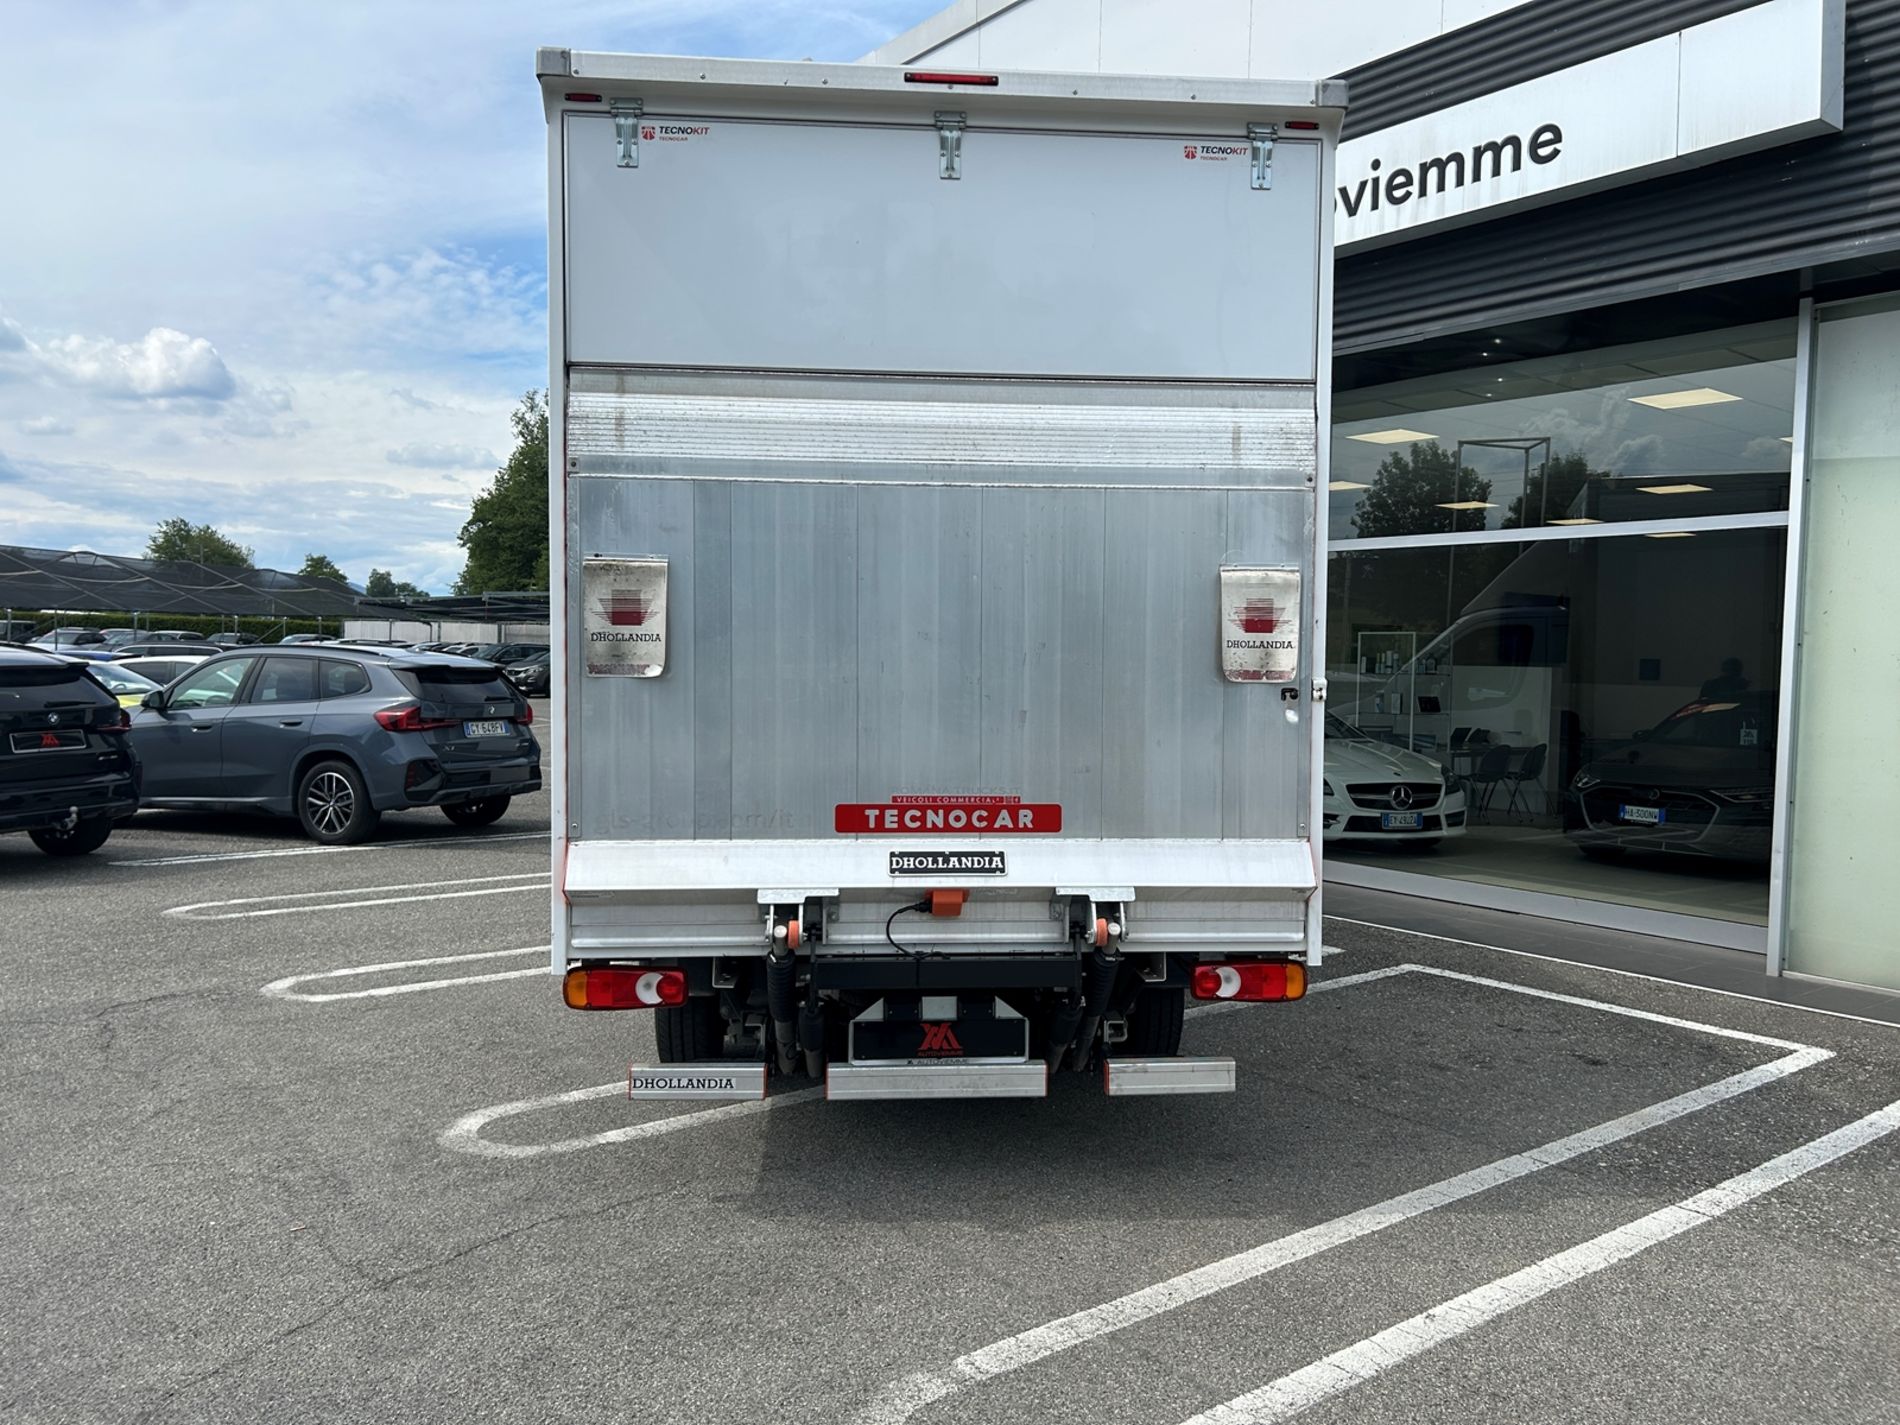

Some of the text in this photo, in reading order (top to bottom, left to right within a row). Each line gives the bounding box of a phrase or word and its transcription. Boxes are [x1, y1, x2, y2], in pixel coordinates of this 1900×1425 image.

[659, 126, 710, 135] TECNOKIT
[1200, 145, 1248, 155] TECNOKIT
[1334, 123, 1563, 218] viemme
[590, 632, 661, 642] DHOLLANDIA
[1226, 640, 1294, 649] DHOLLANDIA
[864, 809, 1035, 829] TECNOCAR
[891, 857, 1004, 869] DHOLLANDIA
[632, 1078, 734, 1089] DHOLLANDIA
